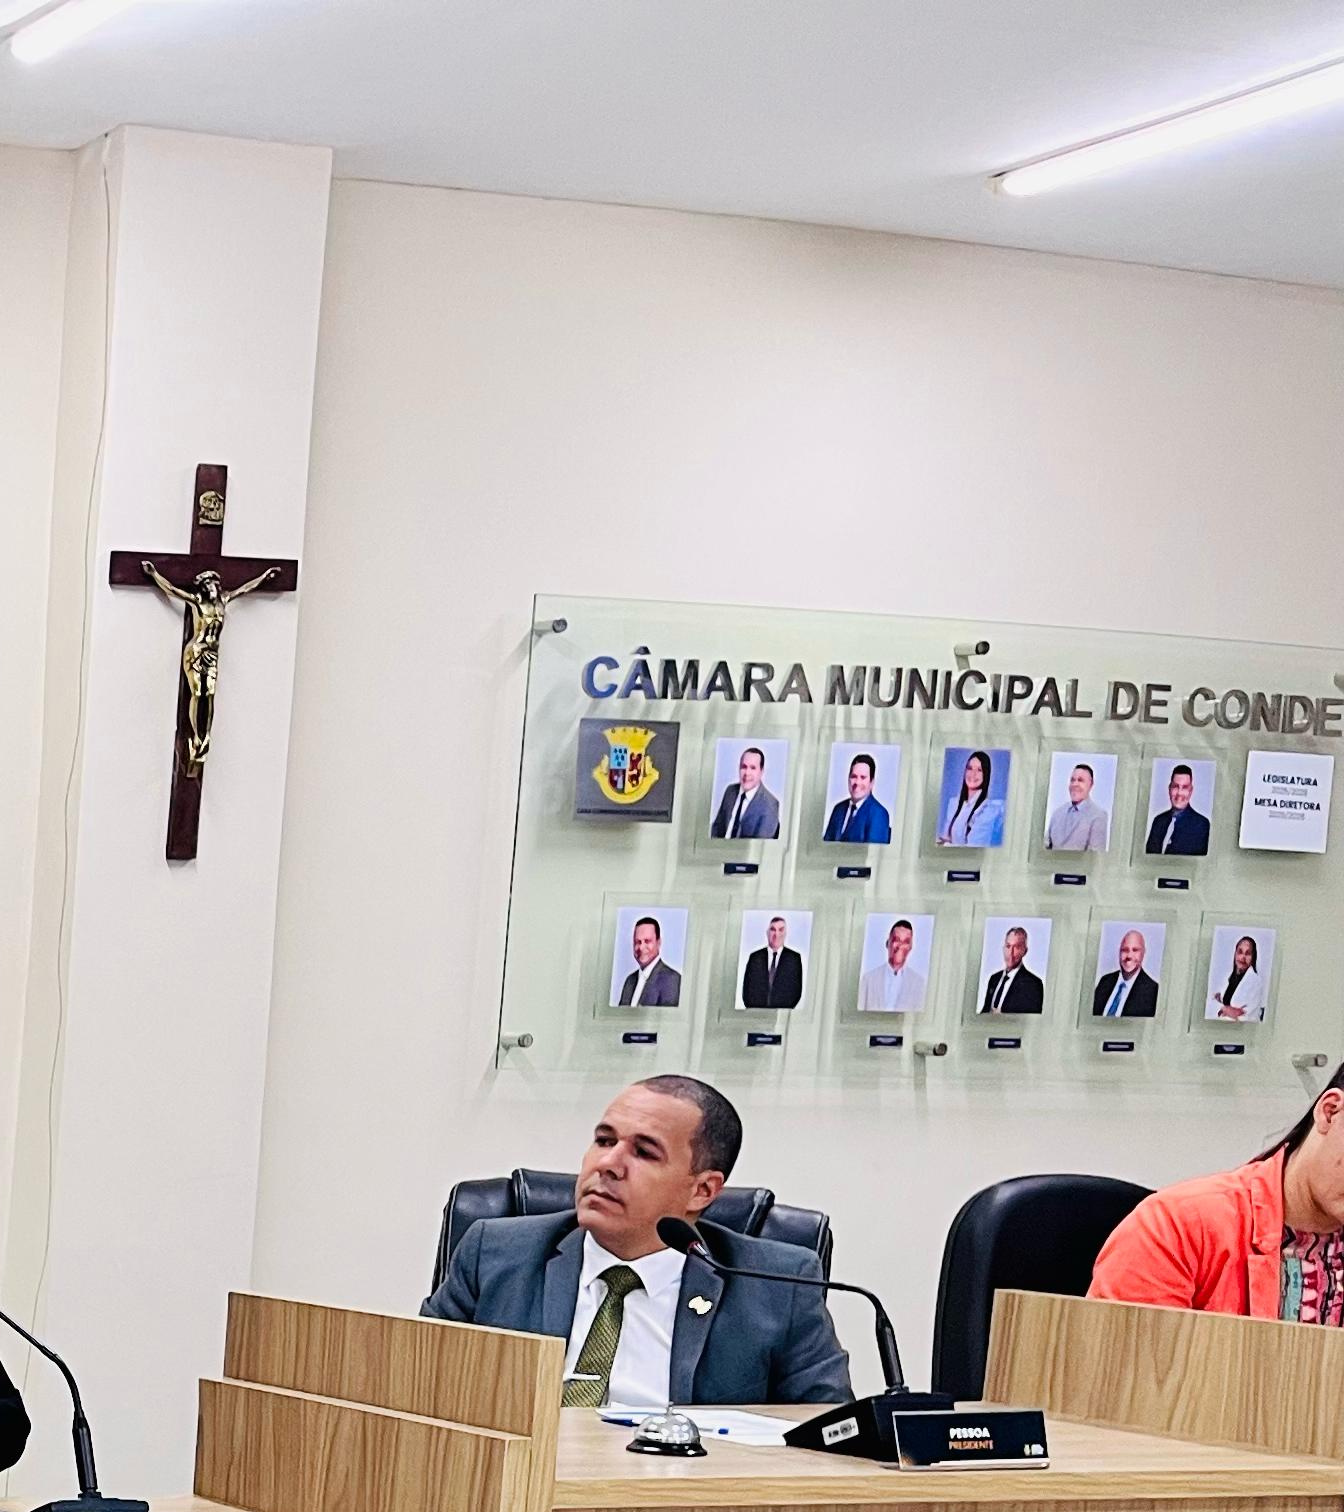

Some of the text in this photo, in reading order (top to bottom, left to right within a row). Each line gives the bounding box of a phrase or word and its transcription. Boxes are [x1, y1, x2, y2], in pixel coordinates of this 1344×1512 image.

[581, 646, 1344, 738] CÂMARA MUNICIPAL DE CONDE
[949, 1426, 991, 1440] PESSOA
